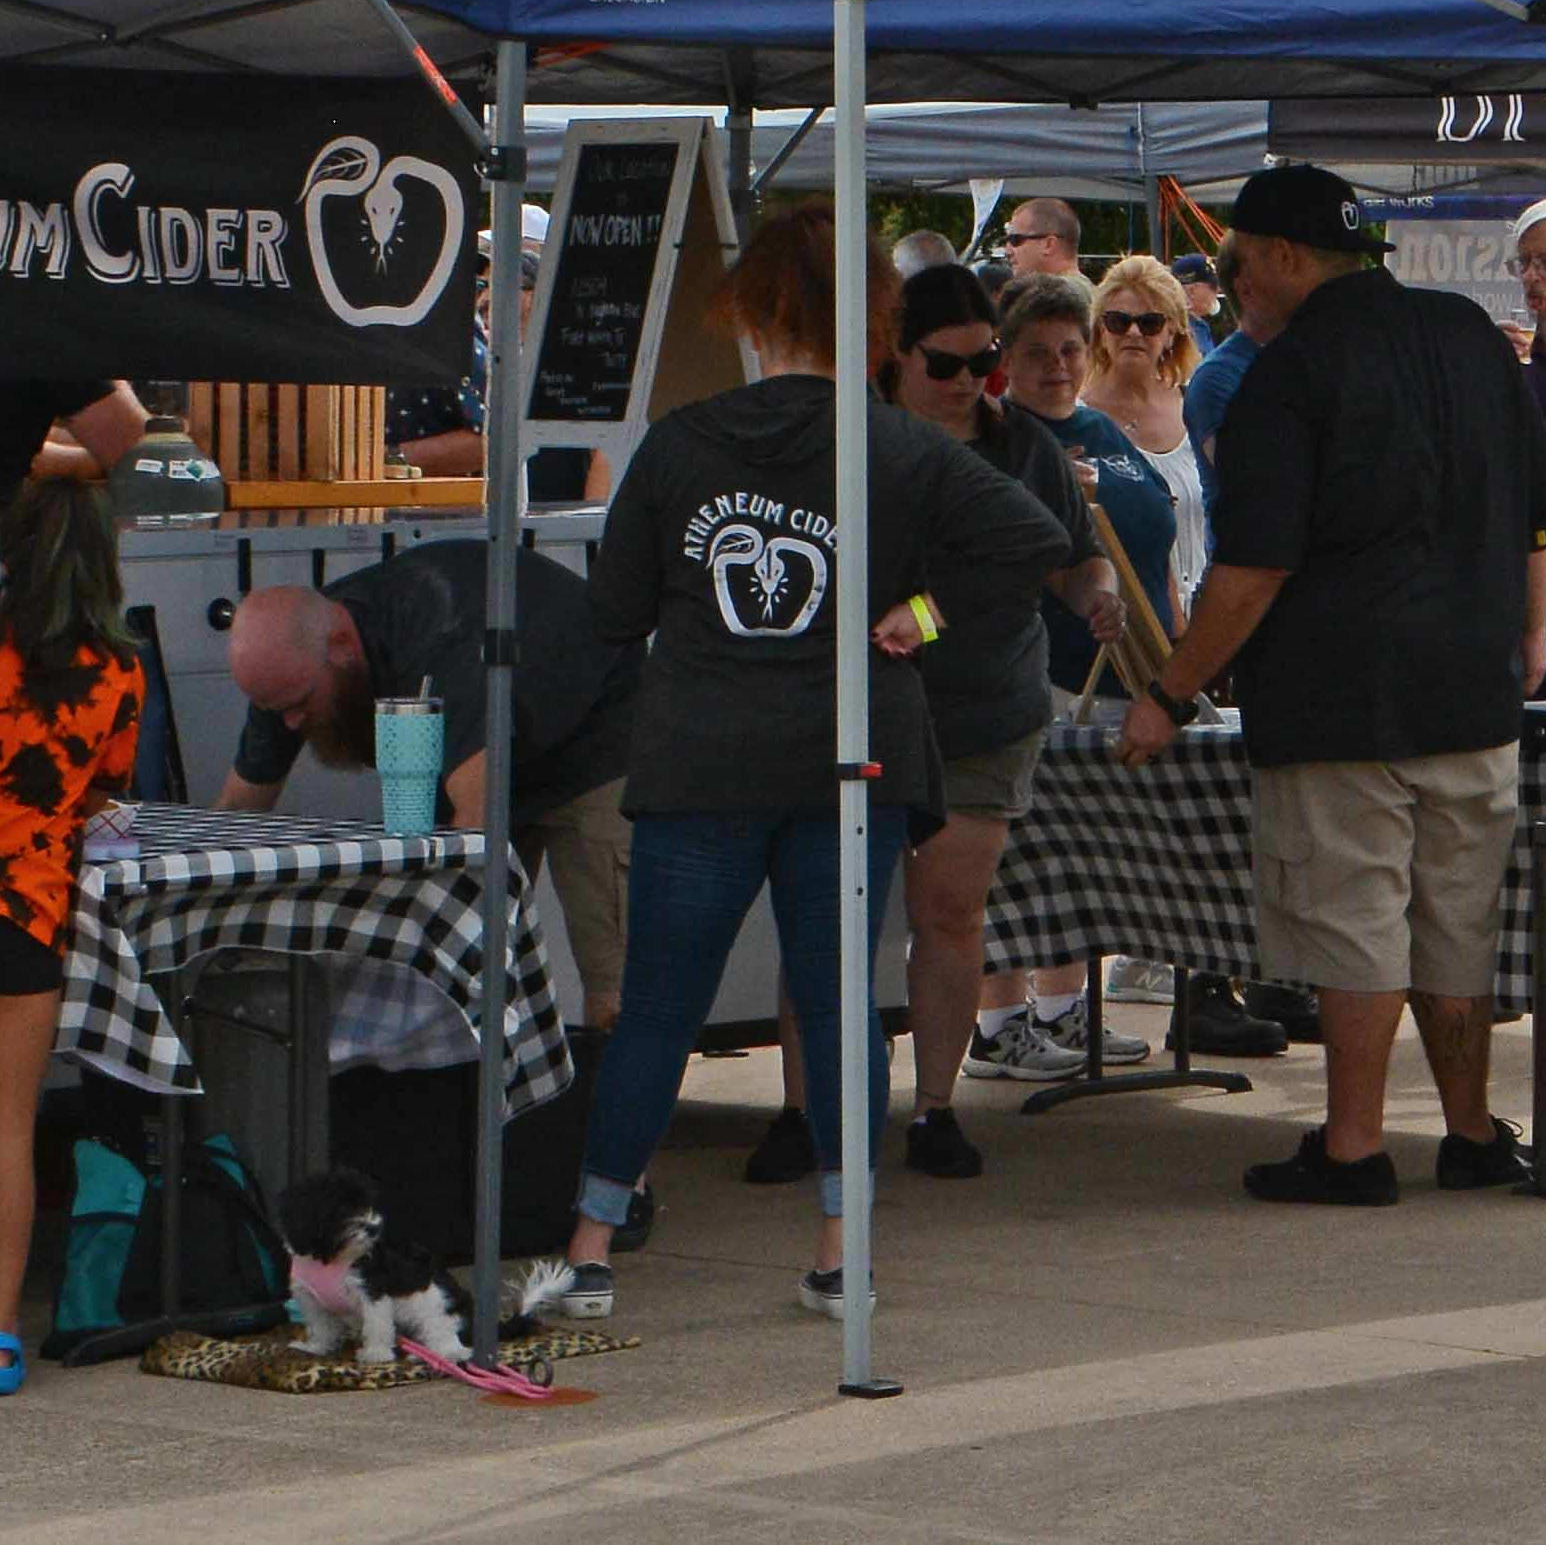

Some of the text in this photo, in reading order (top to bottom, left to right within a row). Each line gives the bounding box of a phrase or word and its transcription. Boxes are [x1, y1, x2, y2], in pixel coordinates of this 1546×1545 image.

[569, 213, 606, 247] NOW
[605, 213, 644, 247] OPEN
[684, 491, 785, 561] ATHENEUM
